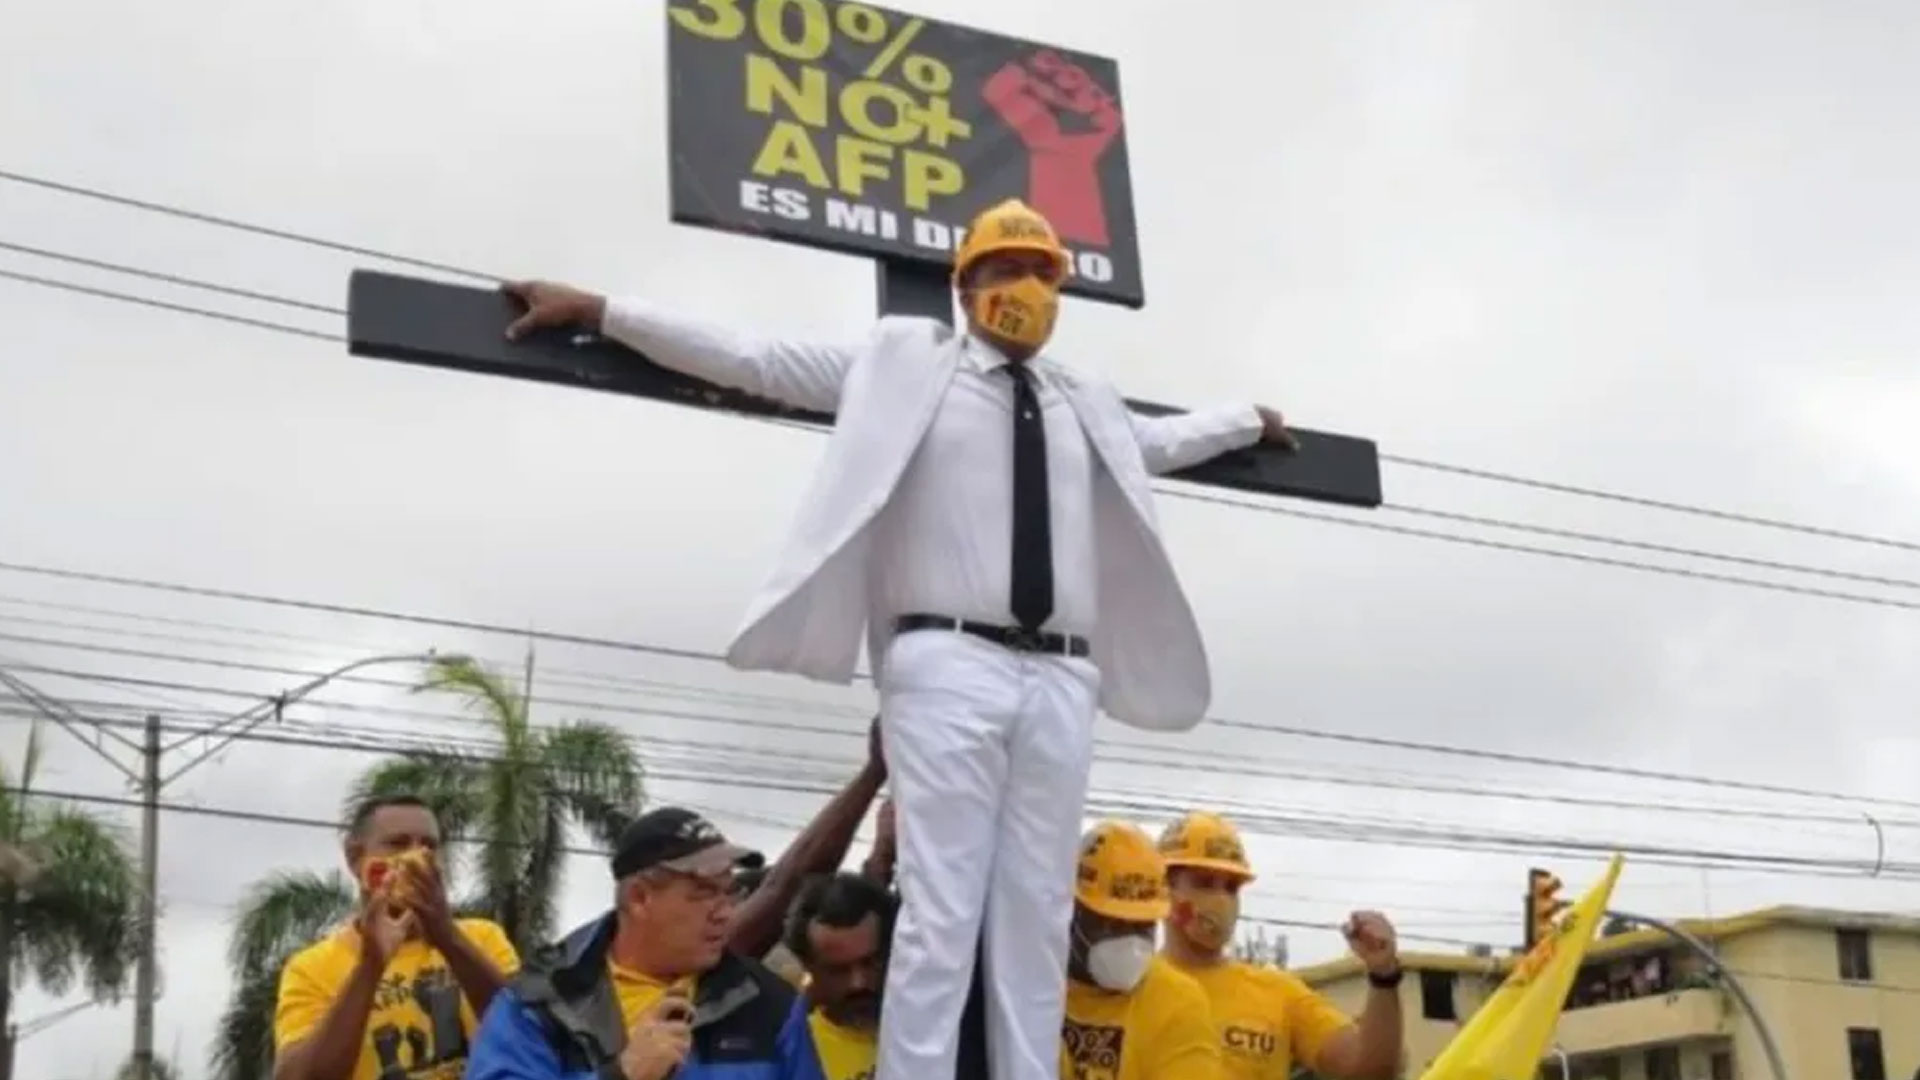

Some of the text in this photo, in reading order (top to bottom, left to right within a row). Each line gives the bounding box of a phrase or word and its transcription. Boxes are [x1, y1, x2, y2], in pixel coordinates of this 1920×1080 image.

[752, 120, 965, 212] AFP
[739, 180, 812, 222] ES
[826, 199, 898, 240] MI
[1224, 1025, 1275, 1056] CTU
